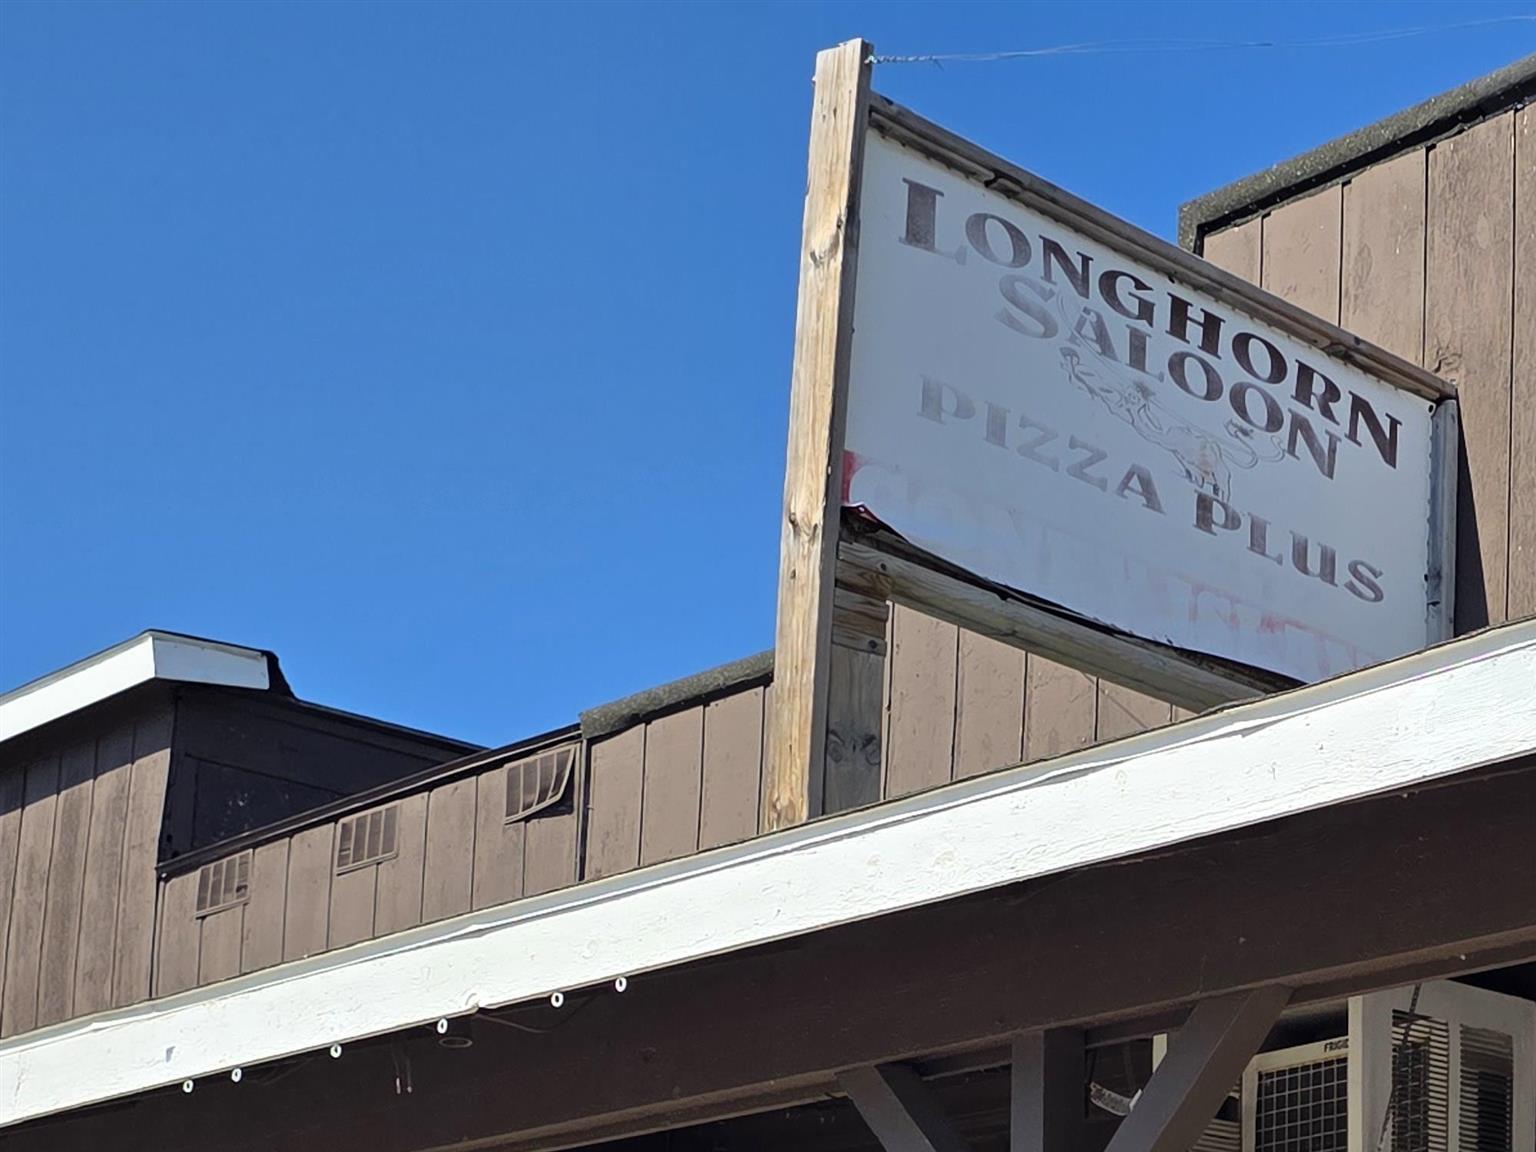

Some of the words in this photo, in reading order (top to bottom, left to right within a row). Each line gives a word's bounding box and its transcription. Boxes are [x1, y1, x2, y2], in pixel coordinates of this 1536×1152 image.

[898, 178, 1401, 469] LONGHORN
[994, 274, 1342, 480] SALOON
[917, 373, 1165, 514] PIZZA
[1194, 490, 1385, 603] PLUS
